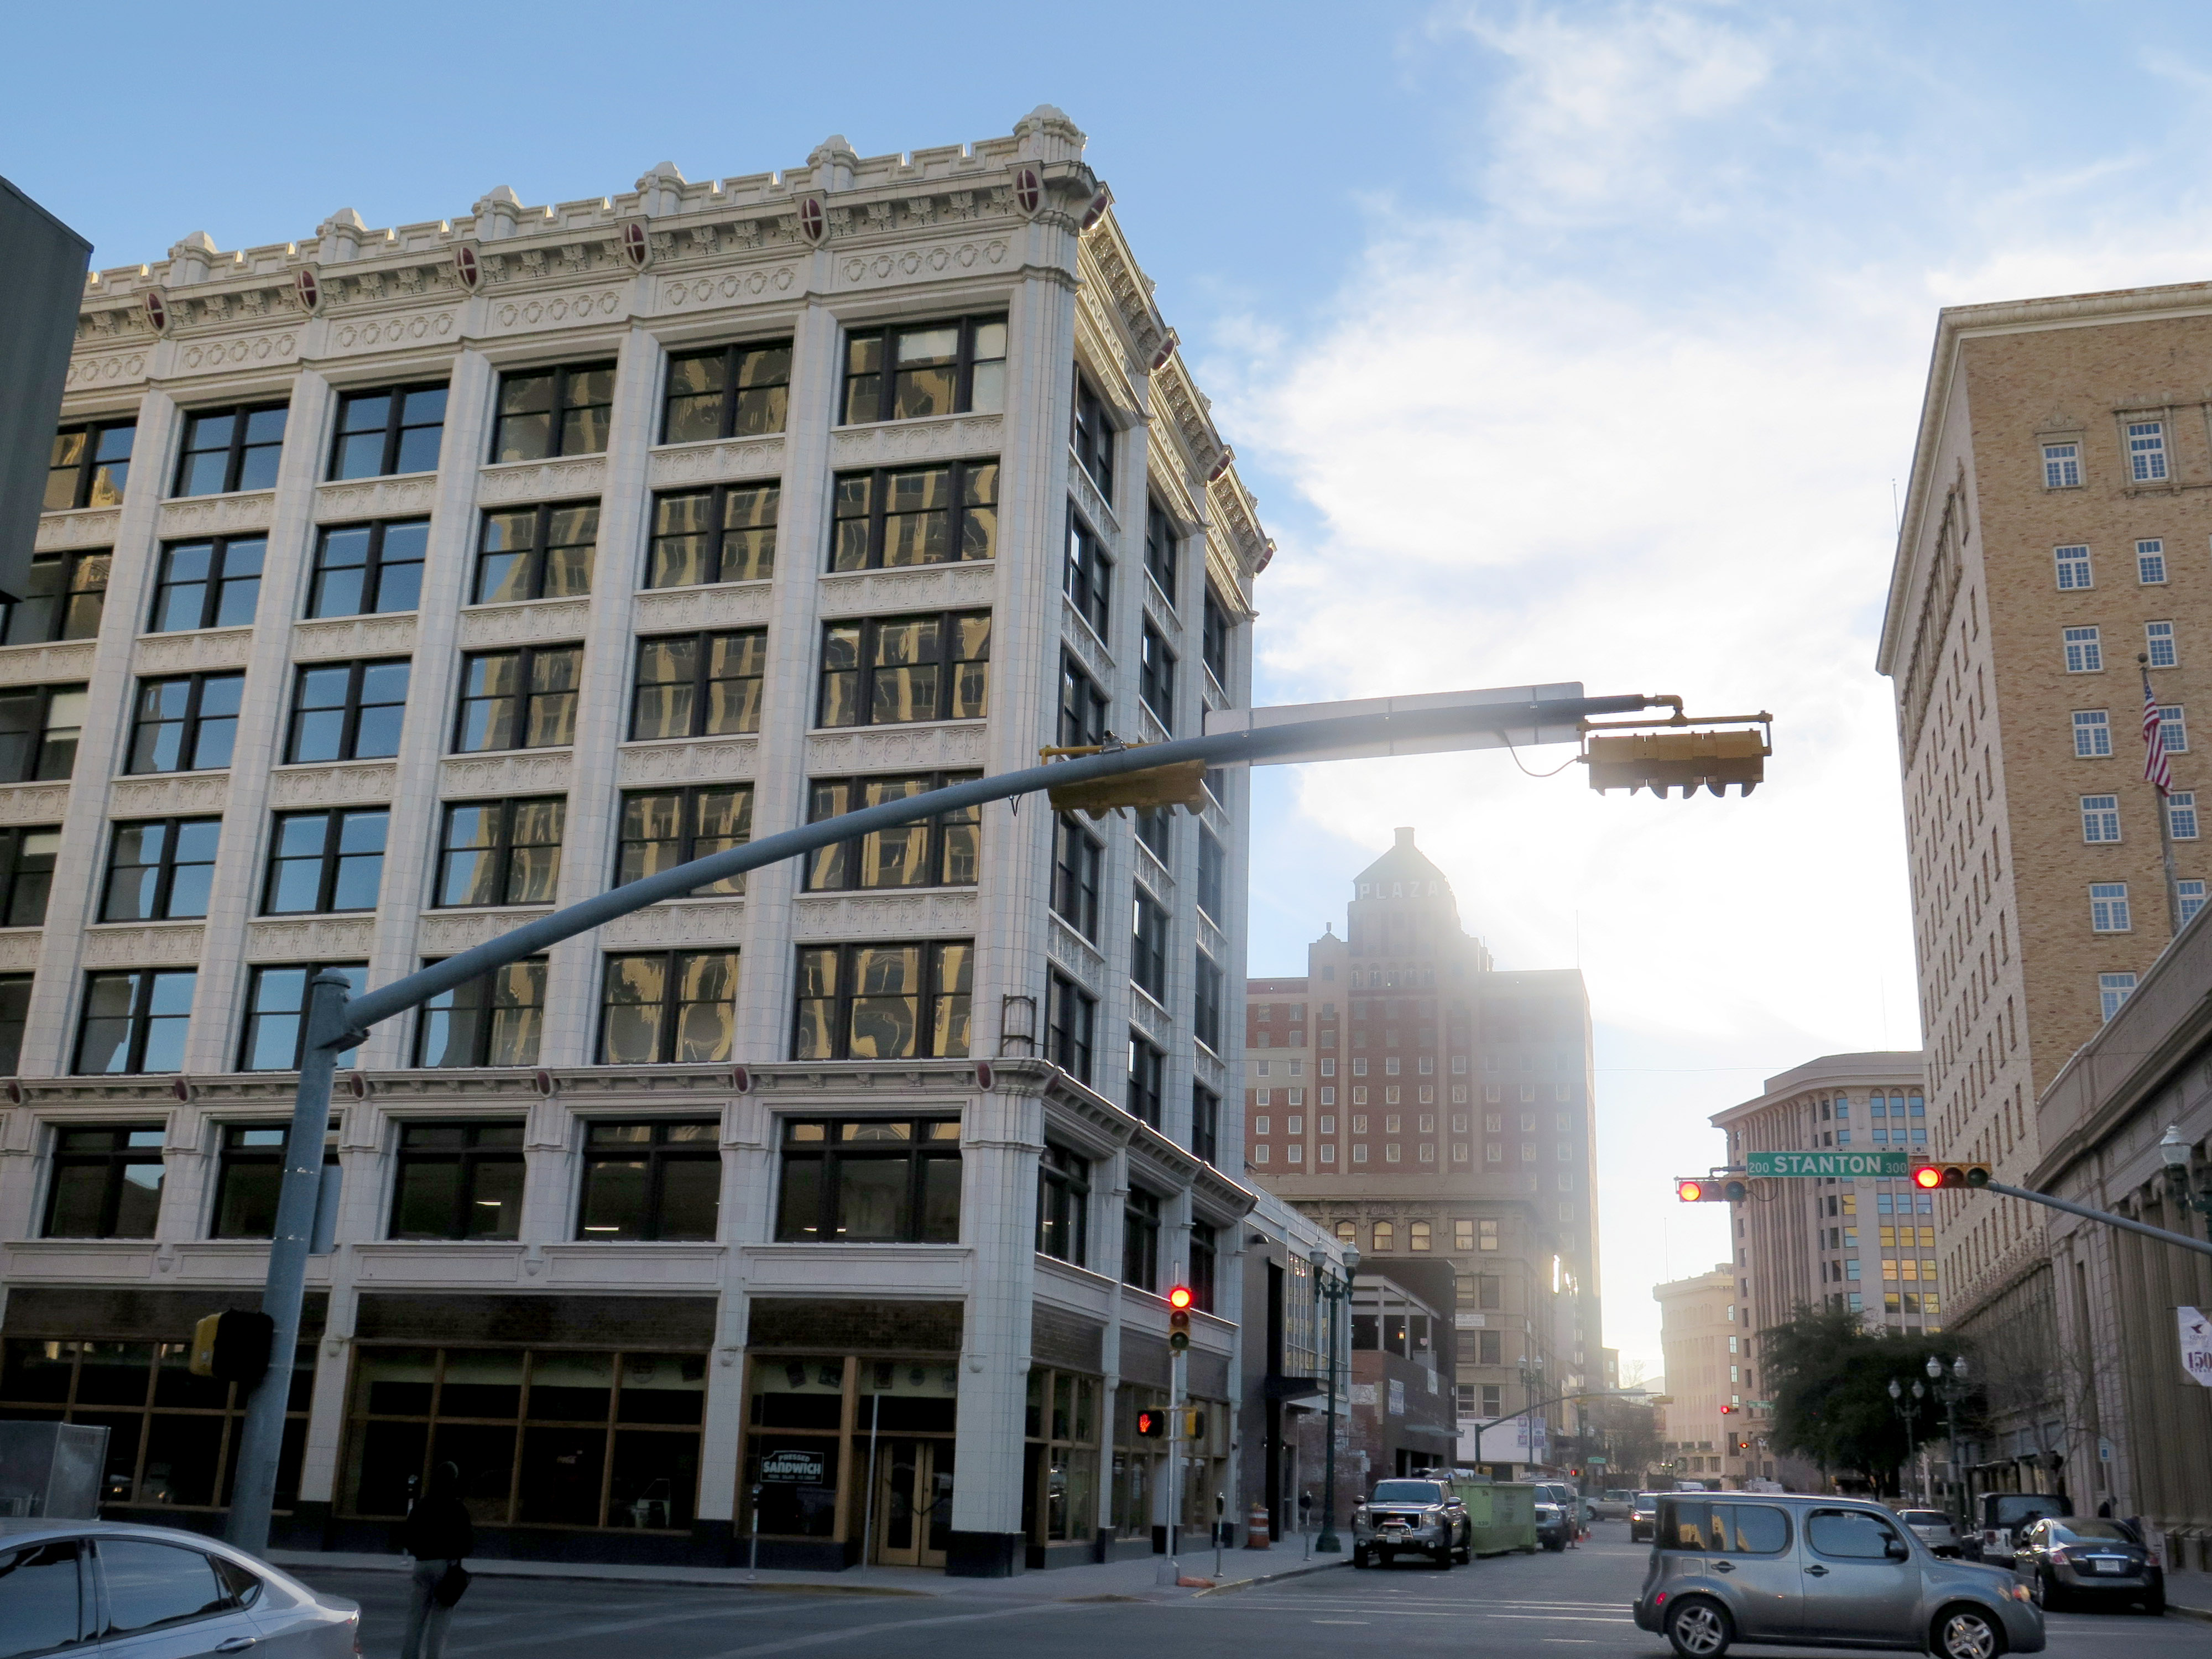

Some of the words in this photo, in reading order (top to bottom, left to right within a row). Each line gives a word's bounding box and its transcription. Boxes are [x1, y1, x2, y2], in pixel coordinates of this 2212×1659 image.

[1359, 880, 1438, 900] PLAZA
[1748, 1162, 1769, 1173] 200
[1774, 1156, 1881, 1173] STANTON
[1886, 1162, 1907, 1173] 300
[2188, 1352, 2212, 1369] 150
[763, 1461, 821, 1474] SANDWICH
